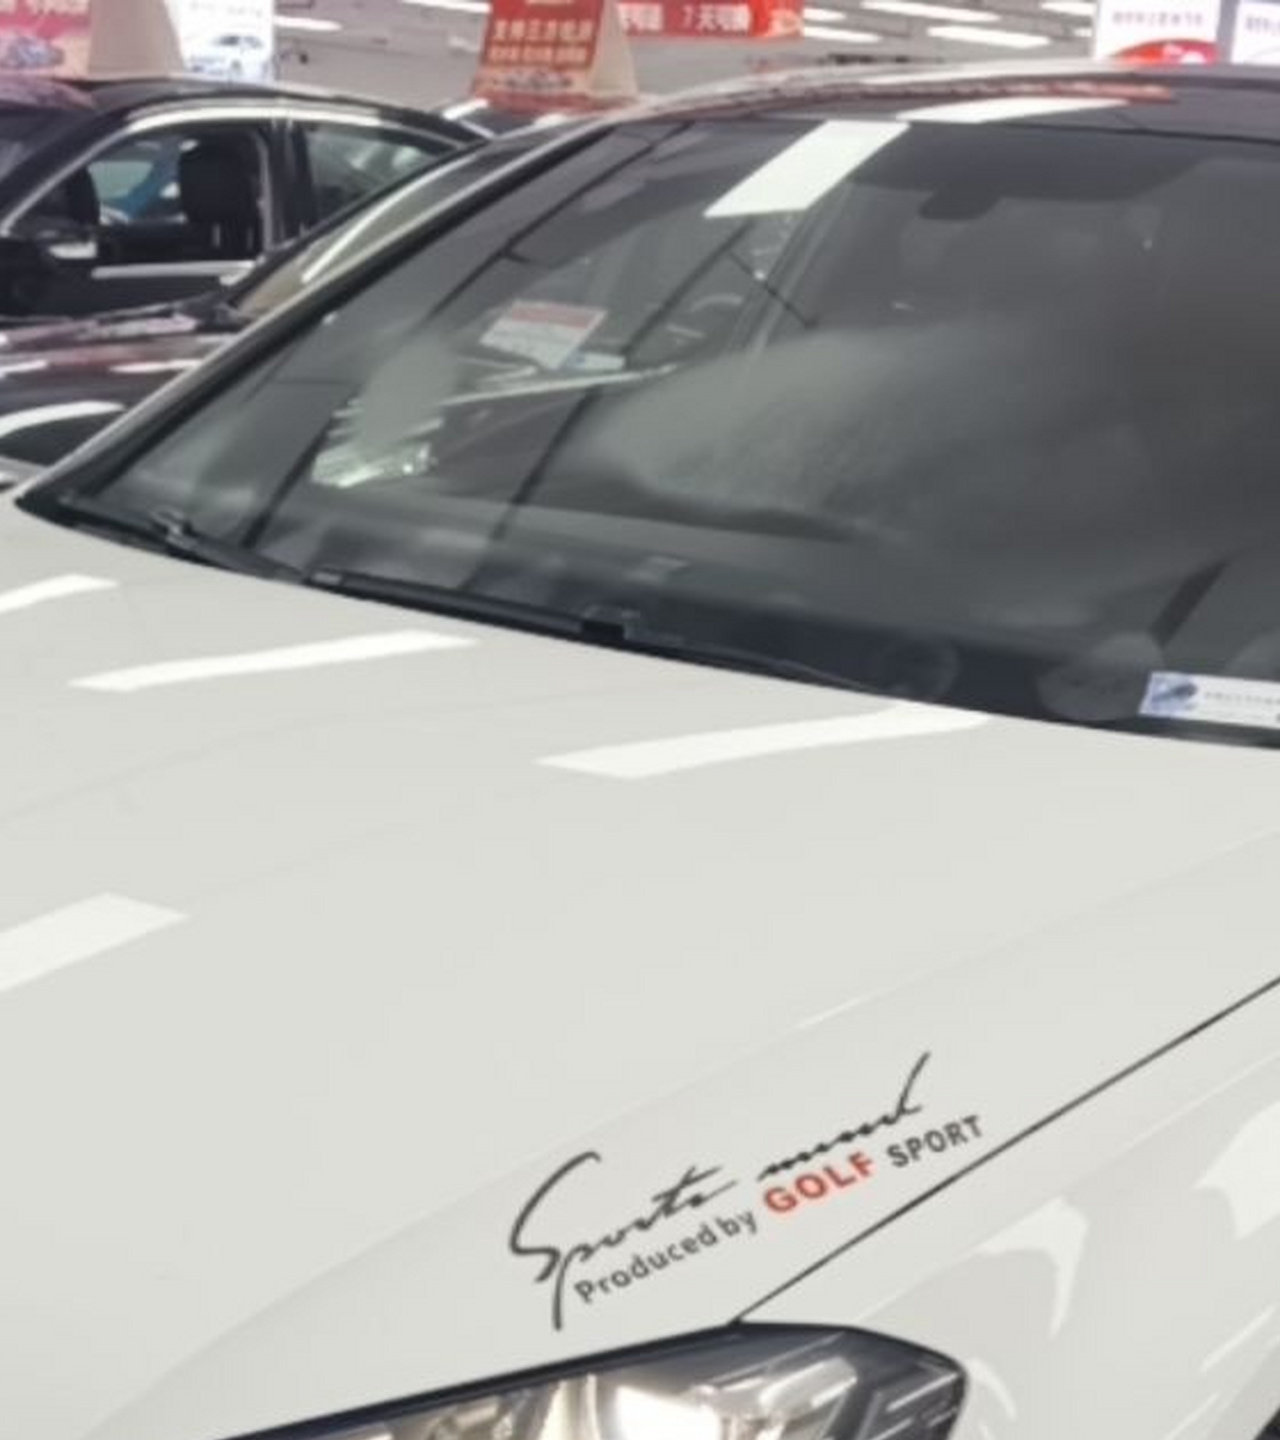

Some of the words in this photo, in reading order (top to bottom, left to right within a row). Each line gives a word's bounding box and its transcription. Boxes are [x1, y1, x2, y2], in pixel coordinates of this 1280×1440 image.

[574, 1218, 720, 1305] Produced
[720, 1208, 758, 1236] by
[762, 1151, 877, 1218] GOLF
[886, 1114, 985, 1169] SPORT
